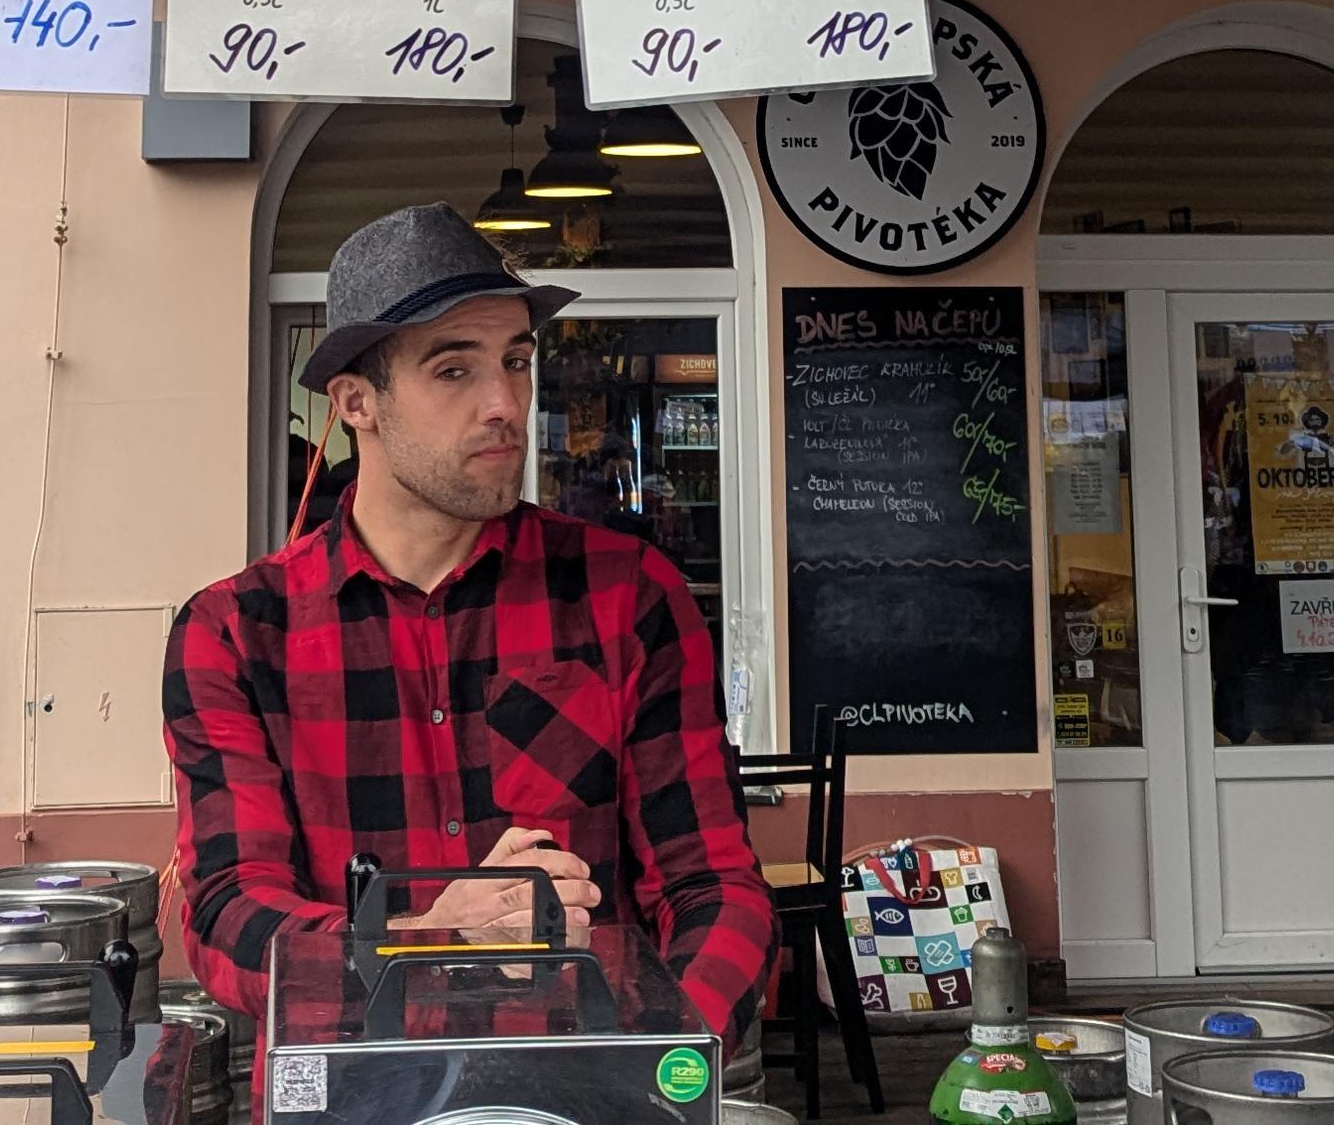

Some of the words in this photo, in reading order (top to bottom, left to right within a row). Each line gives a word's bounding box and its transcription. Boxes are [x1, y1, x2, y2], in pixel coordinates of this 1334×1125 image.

[384, 26, 496, 83] 180,-
[780, 137, 819, 148] SINCE
[990, 135, 1026, 148] 2019
[807, 180, 1007, 252] PIVOTÉKA
[794, 310, 877, 344] DNES
[1106, 628, 1124, 643] 16
[839, 701, 975, 727] @CLPIVOTEKA
[671, 1066, 705, 1076] R290
